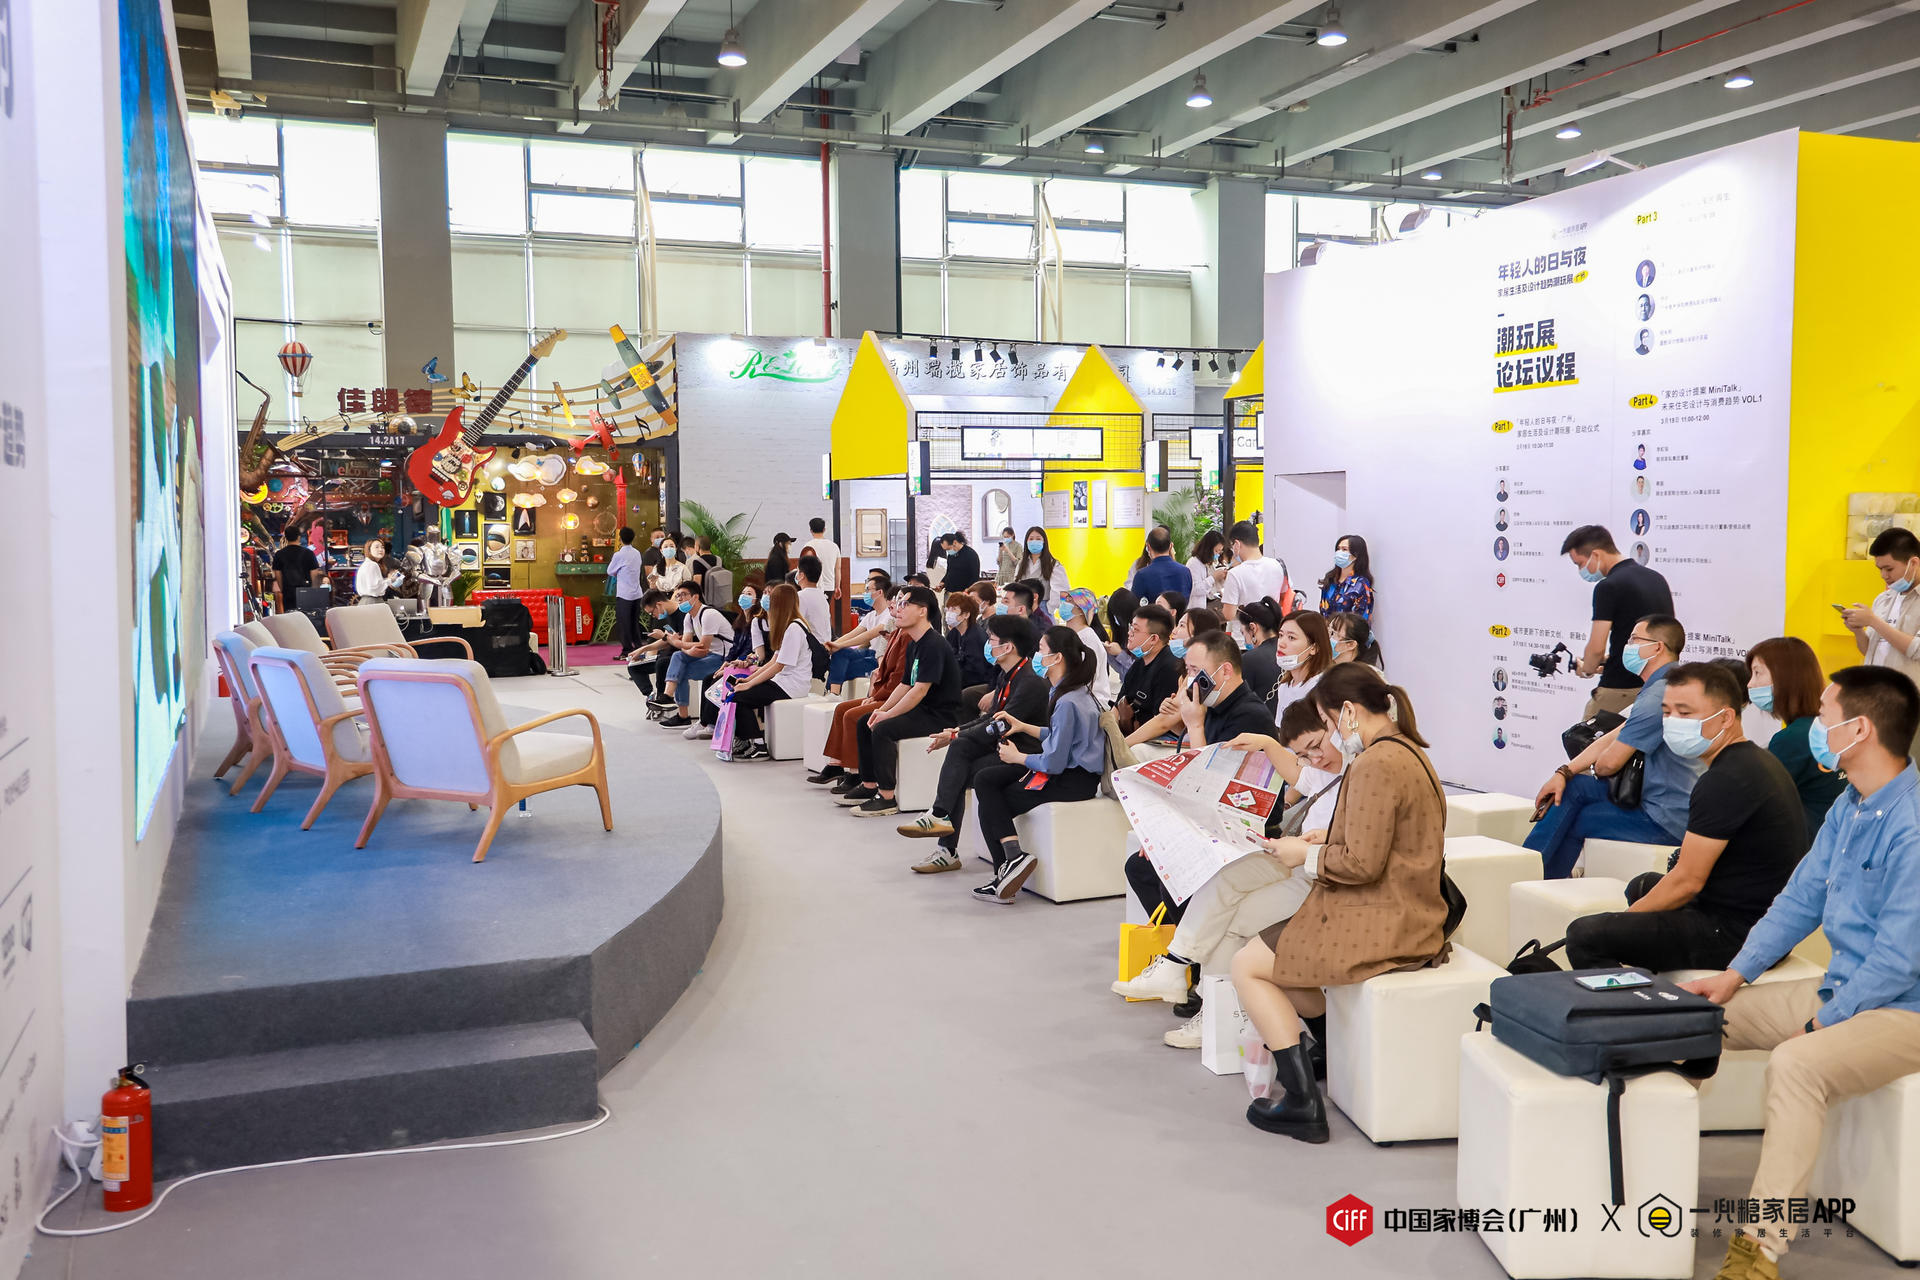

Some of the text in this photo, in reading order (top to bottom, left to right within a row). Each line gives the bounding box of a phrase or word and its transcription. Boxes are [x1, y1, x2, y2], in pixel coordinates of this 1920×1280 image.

[1637, 211, 1658, 225] Part 3
[1498, 246, 1587, 281] 年轻人的日与夜
[1497, 319, 1554, 354] 潮玩展
[1496, 352, 1576, 388] 论坛议程
[1633, 395, 1654, 407] Part 4
[1662, 394, 1763, 411] 未来住宅设计与消费趋势 VOL.1
[1494, 422, 1506, 432] Part
[369, 435, 405, 445] 14.2A17
[1492, 626, 1508, 636] Part 2
[1736, 649, 1749, 658] VO
